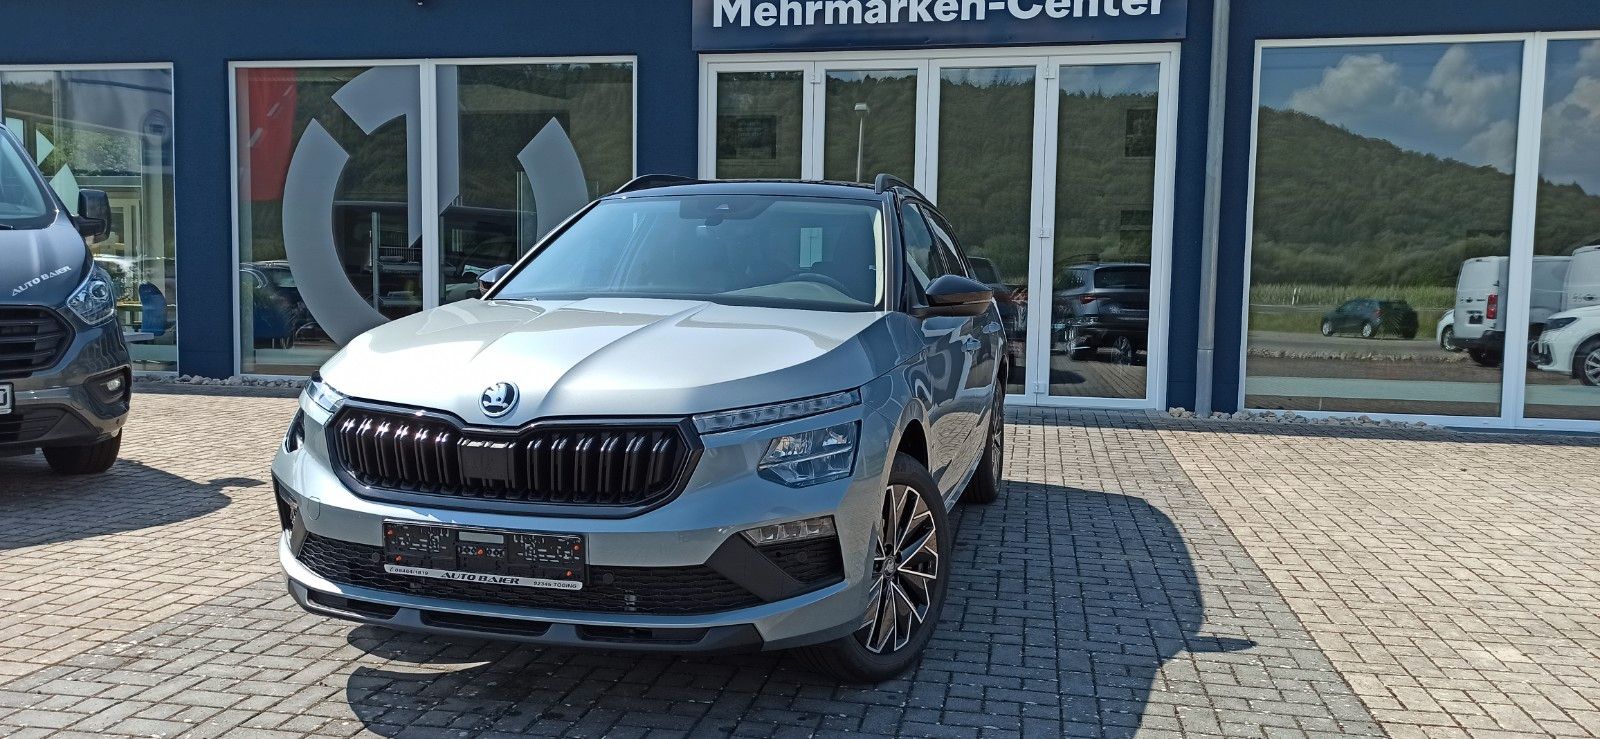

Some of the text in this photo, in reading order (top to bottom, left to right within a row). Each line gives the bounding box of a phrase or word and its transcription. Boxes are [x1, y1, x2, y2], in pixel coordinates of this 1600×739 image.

[712, 0, 1162, 28] Mehrmarken-Center
[11, 265, 72, 297] AUTO BAIER
[440, 571, 520, 585] AUTO BAIER
